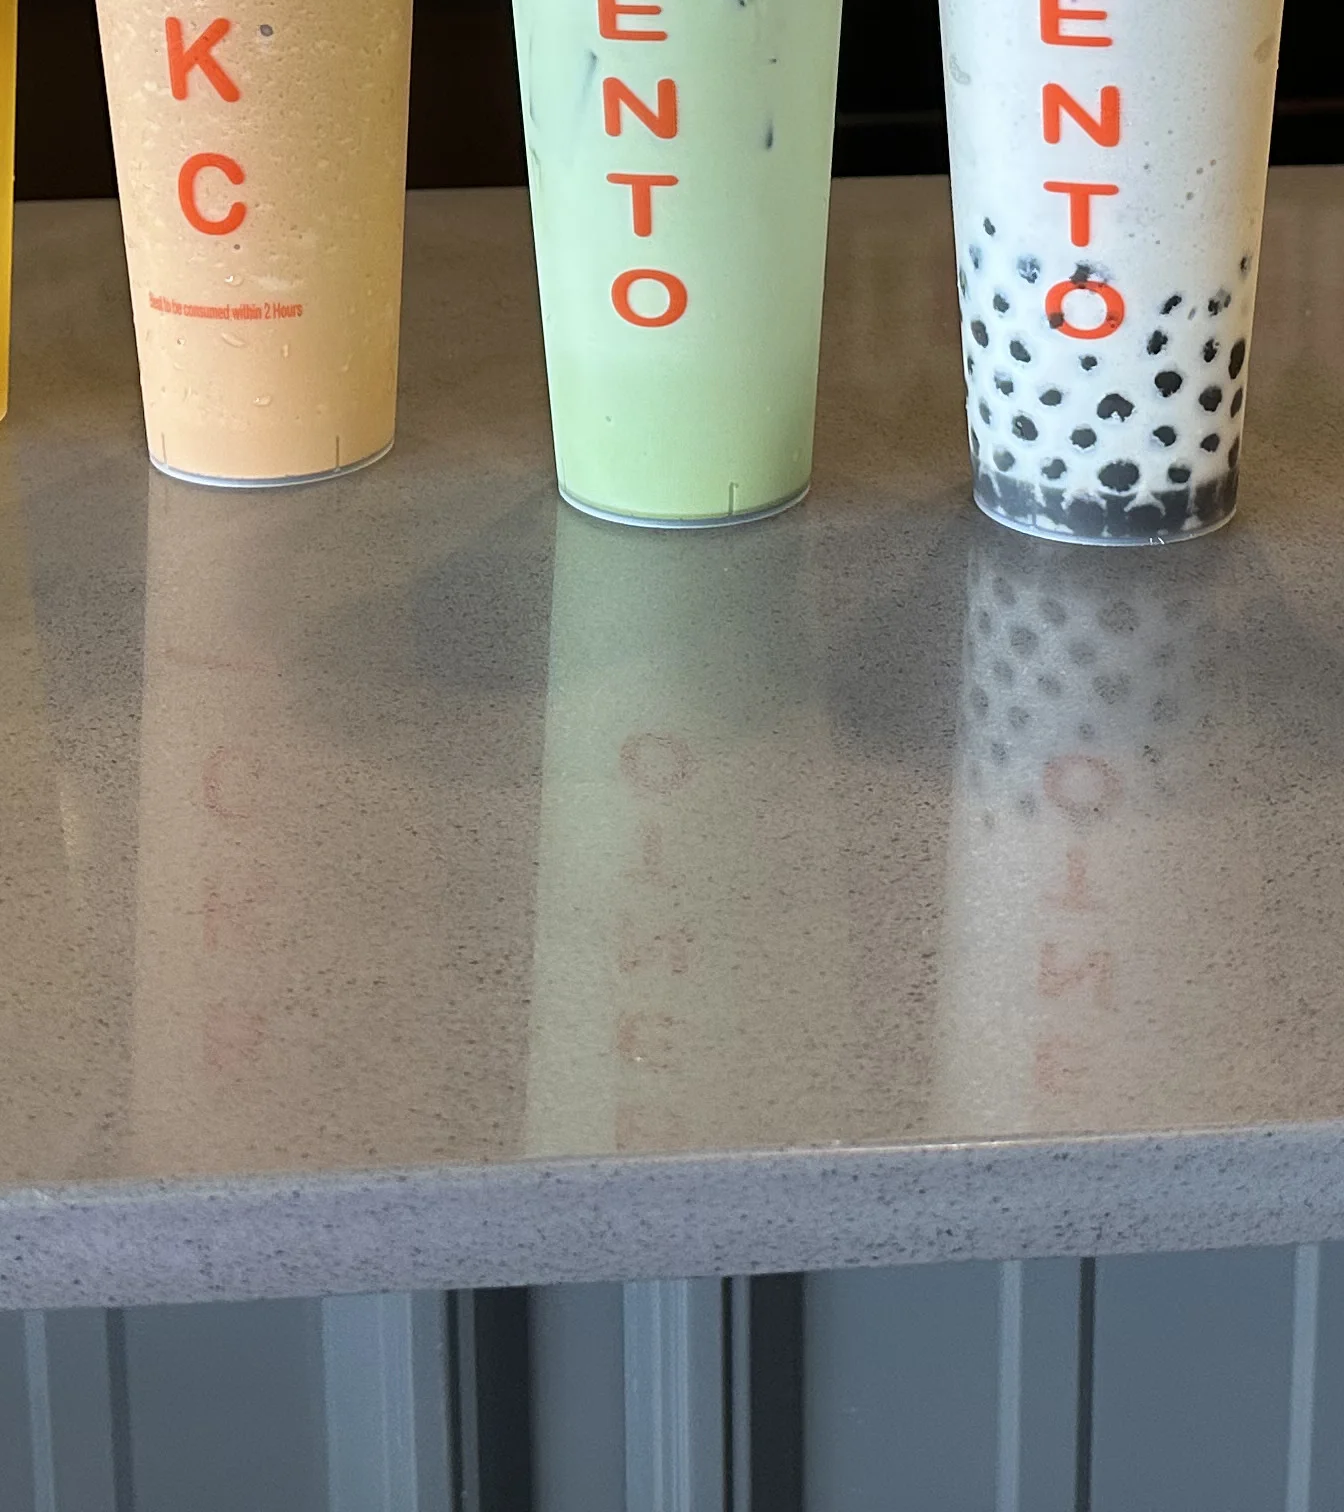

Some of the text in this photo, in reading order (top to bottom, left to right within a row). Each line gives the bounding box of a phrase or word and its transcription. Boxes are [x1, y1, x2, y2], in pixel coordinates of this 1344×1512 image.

[172, 297, 182, 316] be
[183, 303, 230, 320] consumed
[231, 303, 262, 320] within
[263, 302, 271, 320] 2
[272, 302, 304, 320] Hours
